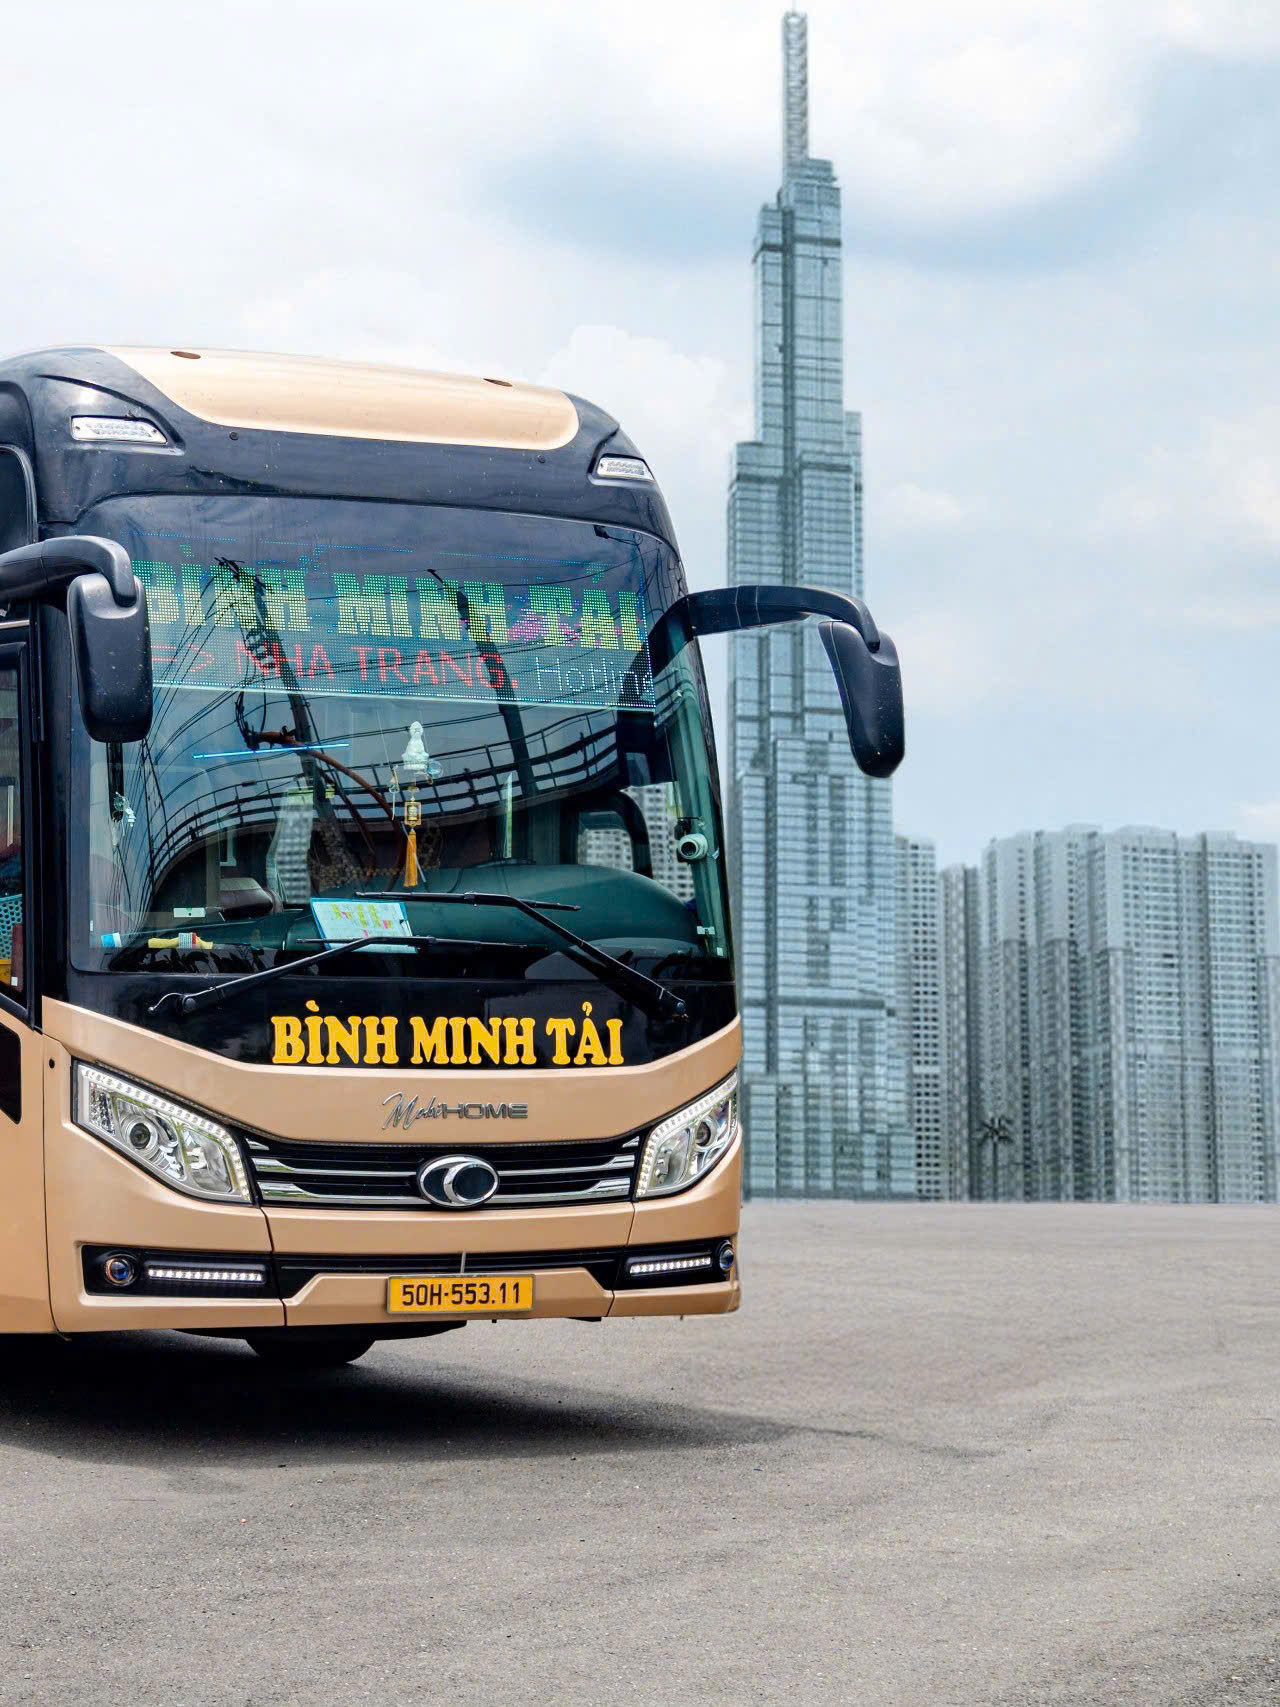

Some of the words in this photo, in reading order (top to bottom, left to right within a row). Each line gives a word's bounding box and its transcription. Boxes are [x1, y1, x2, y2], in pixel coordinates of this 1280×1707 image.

[331, 573, 508, 643] MINH
[235, 640, 335, 680] NHA
[271, 1000, 399, 1065] BÌNH
[410, 1015, 537, 1065] MINH
[545, 1001, 625, 1066] TẢI
[382, 1091, 529, 1131] MobiHOME
[401, 1282, 520, 1307] 50H-553.11
